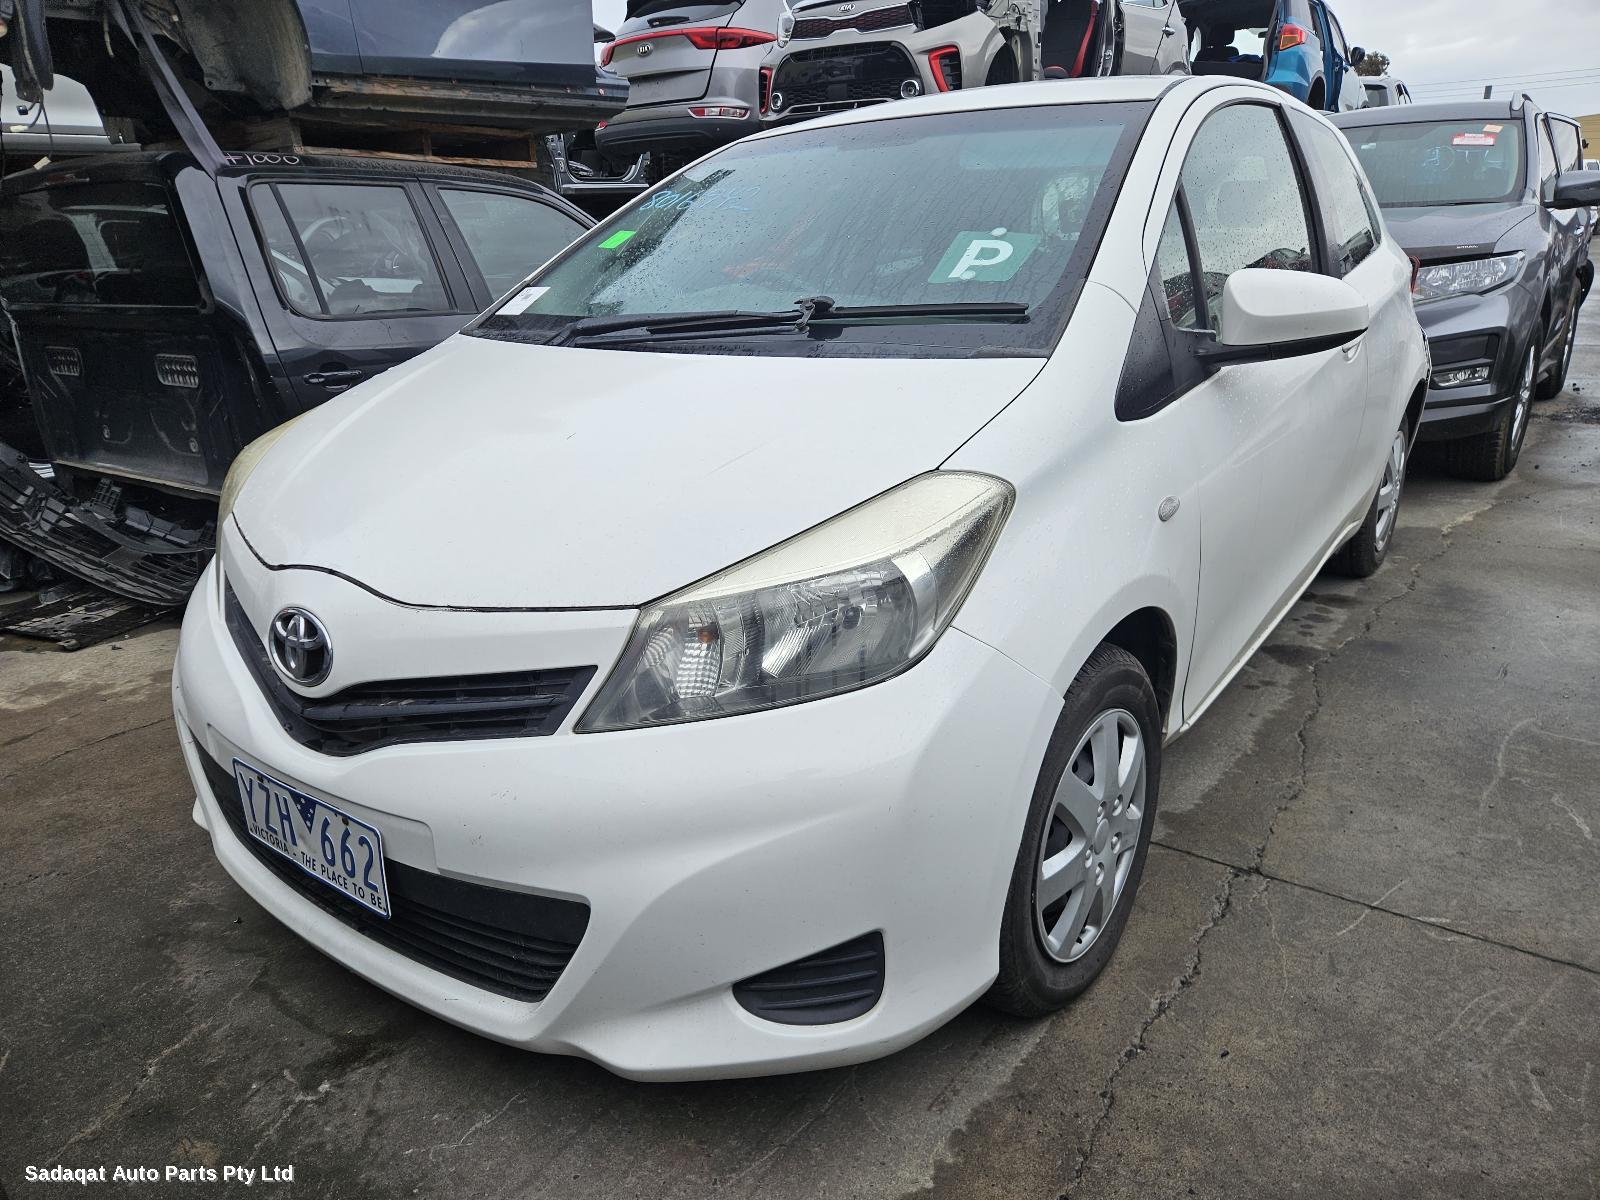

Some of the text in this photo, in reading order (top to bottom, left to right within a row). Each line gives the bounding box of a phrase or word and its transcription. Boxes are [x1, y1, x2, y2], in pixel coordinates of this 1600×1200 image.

[839, 3, 853, 12] KIA
[948, 240, 1014, 278] P
[239, 771, 379, 893] YZH 662
[252, 823, 290, 855] VICTORIA
[301, 851, 316, 871] THE
[321, 864, 348, 890] PLACE
[352, 882, 365, 899] TO
